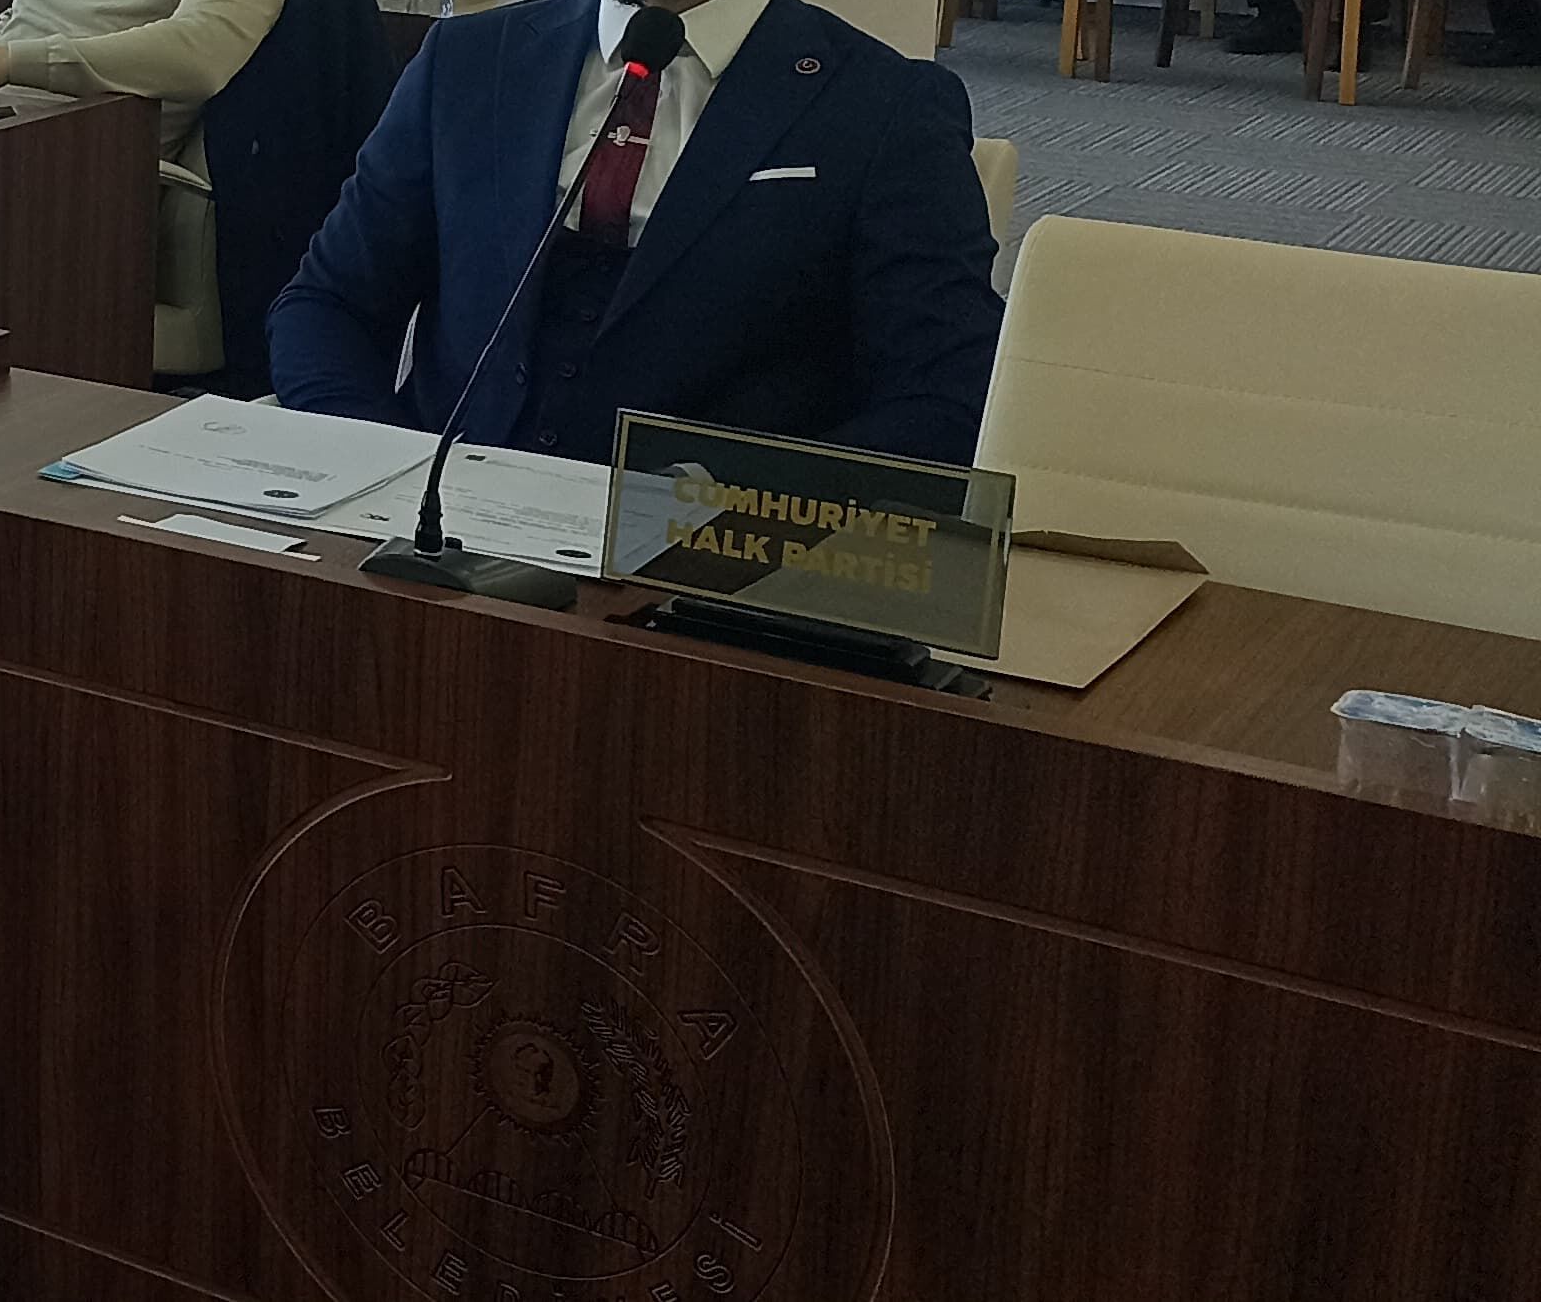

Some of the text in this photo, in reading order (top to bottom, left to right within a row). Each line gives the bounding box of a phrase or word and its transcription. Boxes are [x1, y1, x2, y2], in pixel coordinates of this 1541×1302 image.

[672, 475, 937, 548] CUMHURİYET
[665, 518, 934, 594] HALK PARTİSİ
[344, 865, 739, 1063] BAFRA
